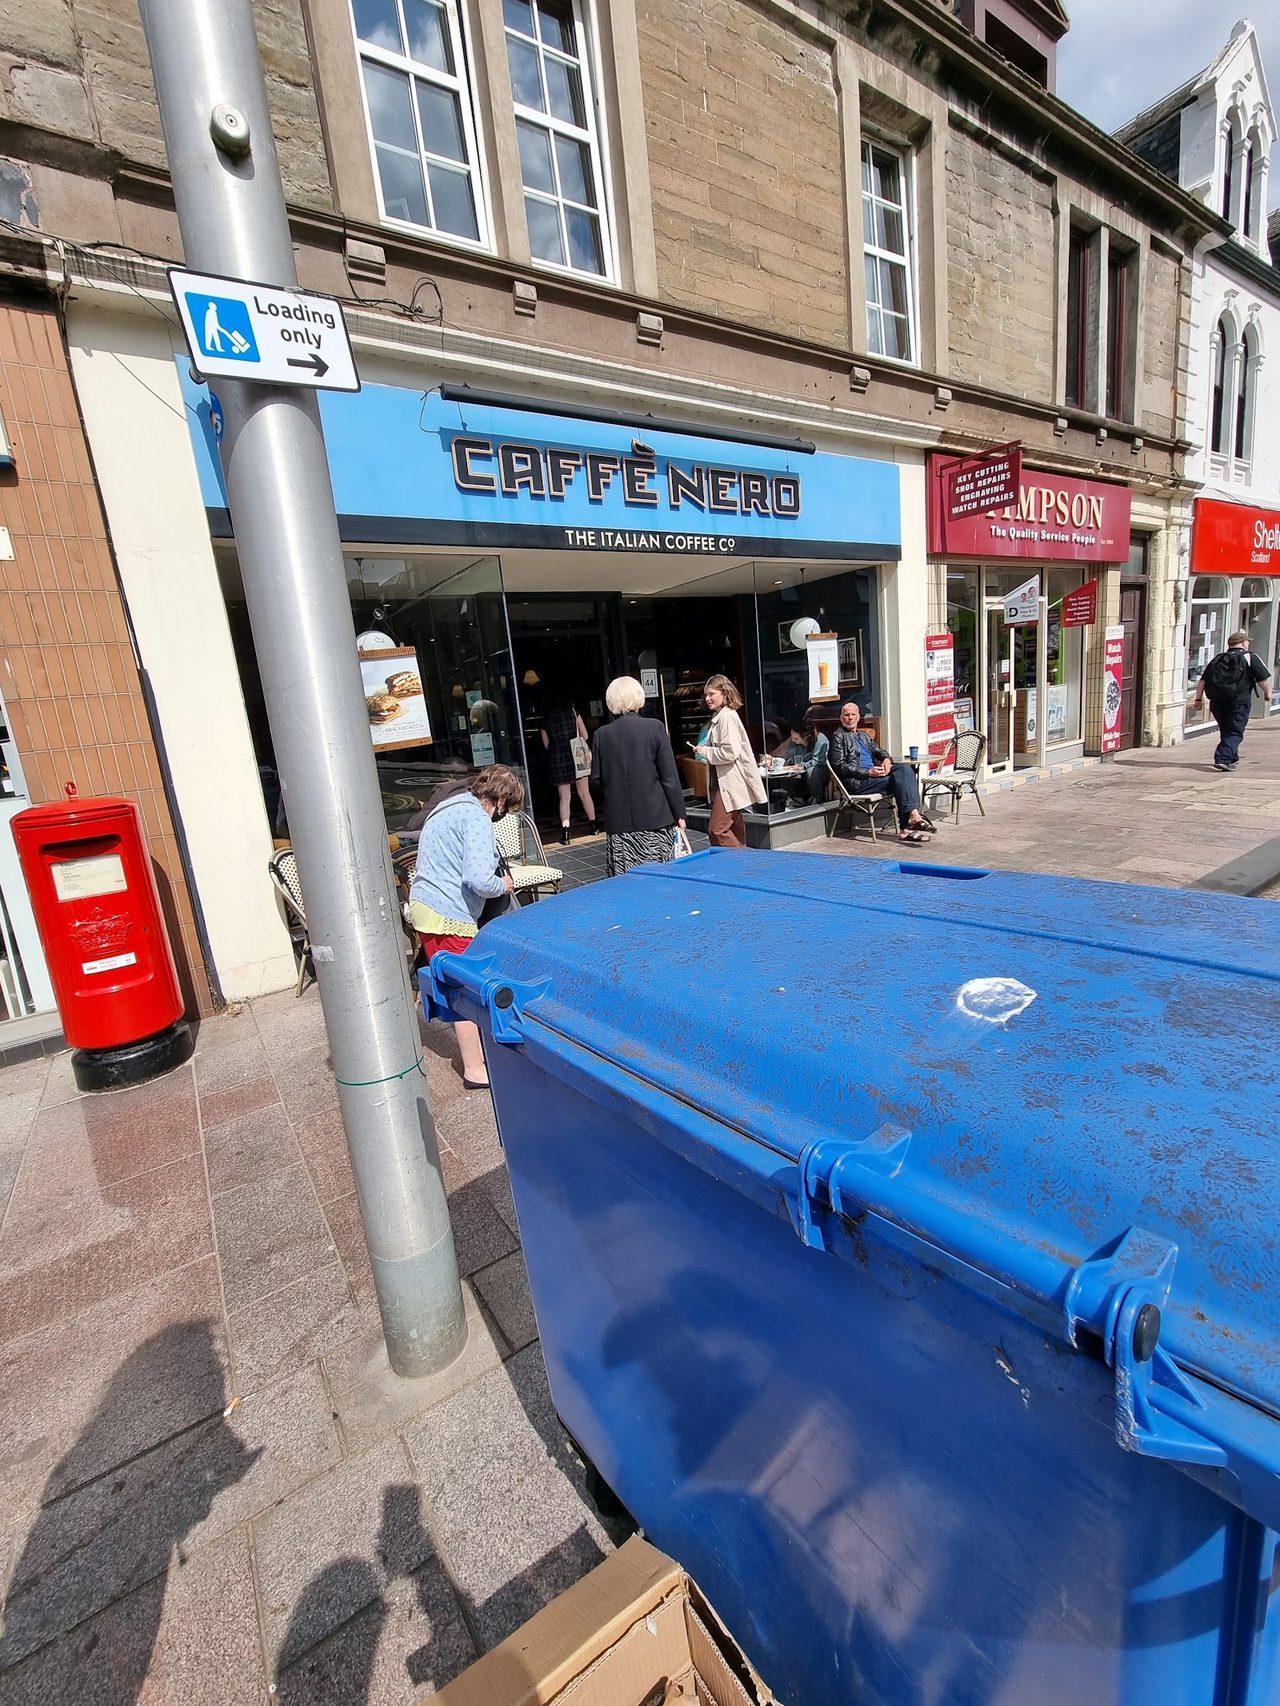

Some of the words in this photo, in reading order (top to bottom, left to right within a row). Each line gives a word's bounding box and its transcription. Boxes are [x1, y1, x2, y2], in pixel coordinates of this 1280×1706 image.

[254, 296, 335, 329] Loading
[280, 328, 322, 350] only
[451, 438, 660, 505] CAFFÈ
[667, 461, 802, 517] NERO
[955, 482, 974, 494] SHOE
[977, 472, 1011, 488] REPAIRS
[957, 472, 973, 484] KEY
[975, 462, 1010, 478] CUTTING
[952, 502, 978, 515] WATCH
[980, 492, 1014, 507] REPAIRS
[960, 484, 1005, 502] ENGRAVING
[985, 485, 1105, 530] MPSON
[564, 530, 596, 547] THE
[600, 531, 660, 550] ITALIAN
[664, 535, 716, 552] COFFEE
[990, 525, 1007, 538] The
[1010, 526, 1039, 542] Quality
[1041, 530, 1070, 542] Service
[1072, 532, 1096, 546] People
[1250, 551, 1270, 564] Scotland
[1106, 655, 1122, 666] Repairs
